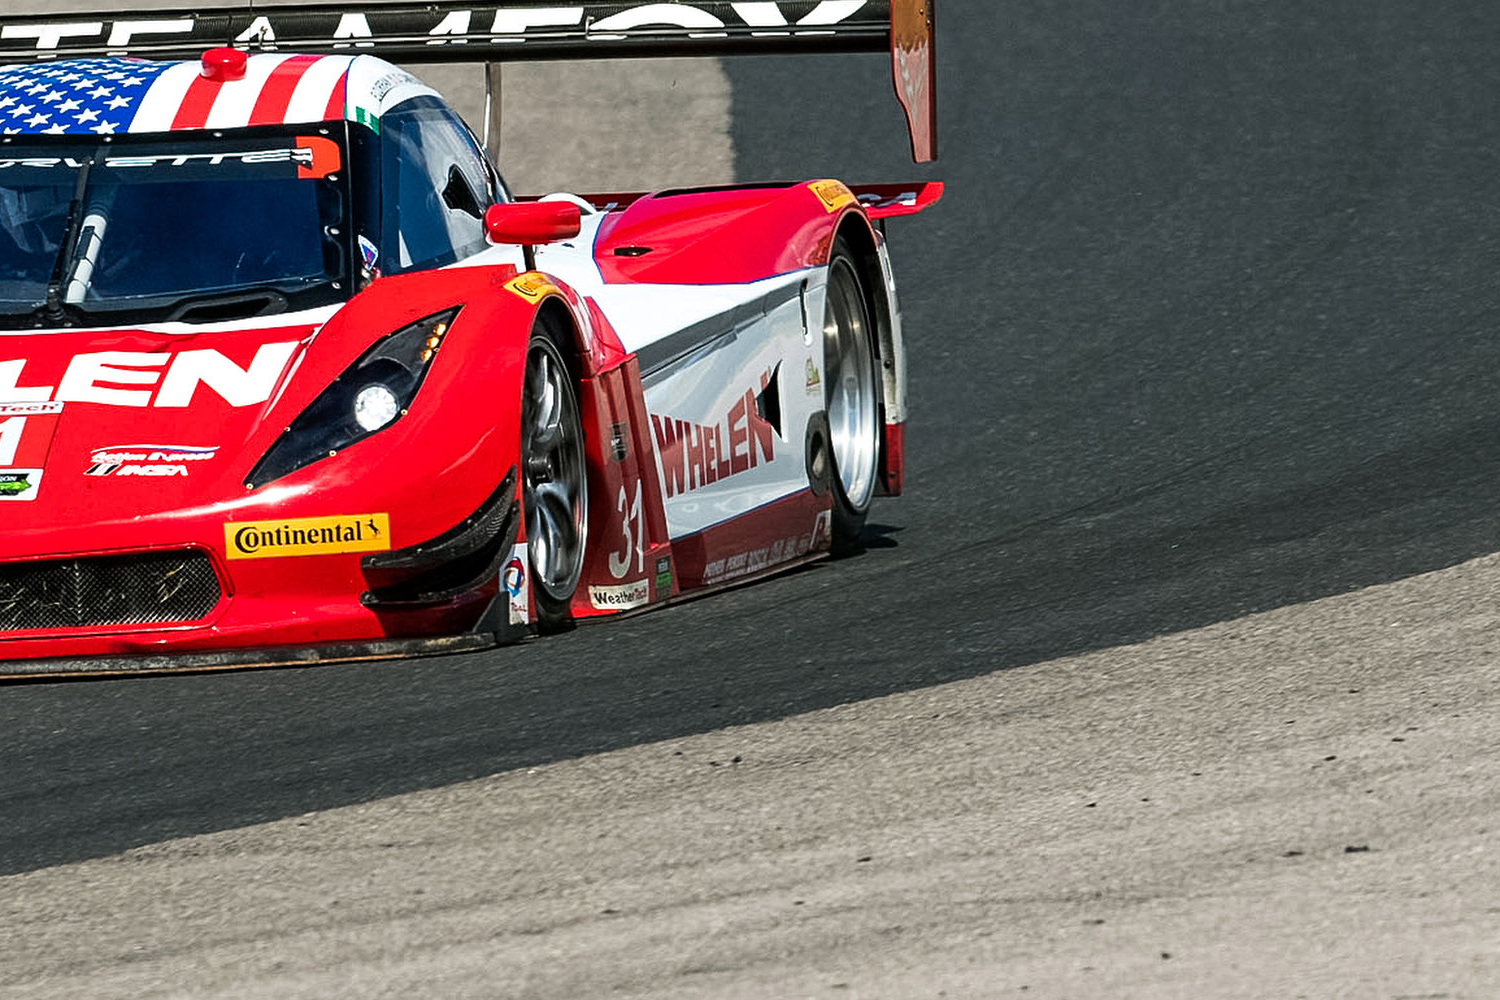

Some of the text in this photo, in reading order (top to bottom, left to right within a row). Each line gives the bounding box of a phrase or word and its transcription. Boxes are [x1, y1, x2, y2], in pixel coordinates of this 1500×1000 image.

[650, 371, 775, 499] WHELEN
[234, 520, 363, 554] Continental
[608, 479, 644, 579] 31
